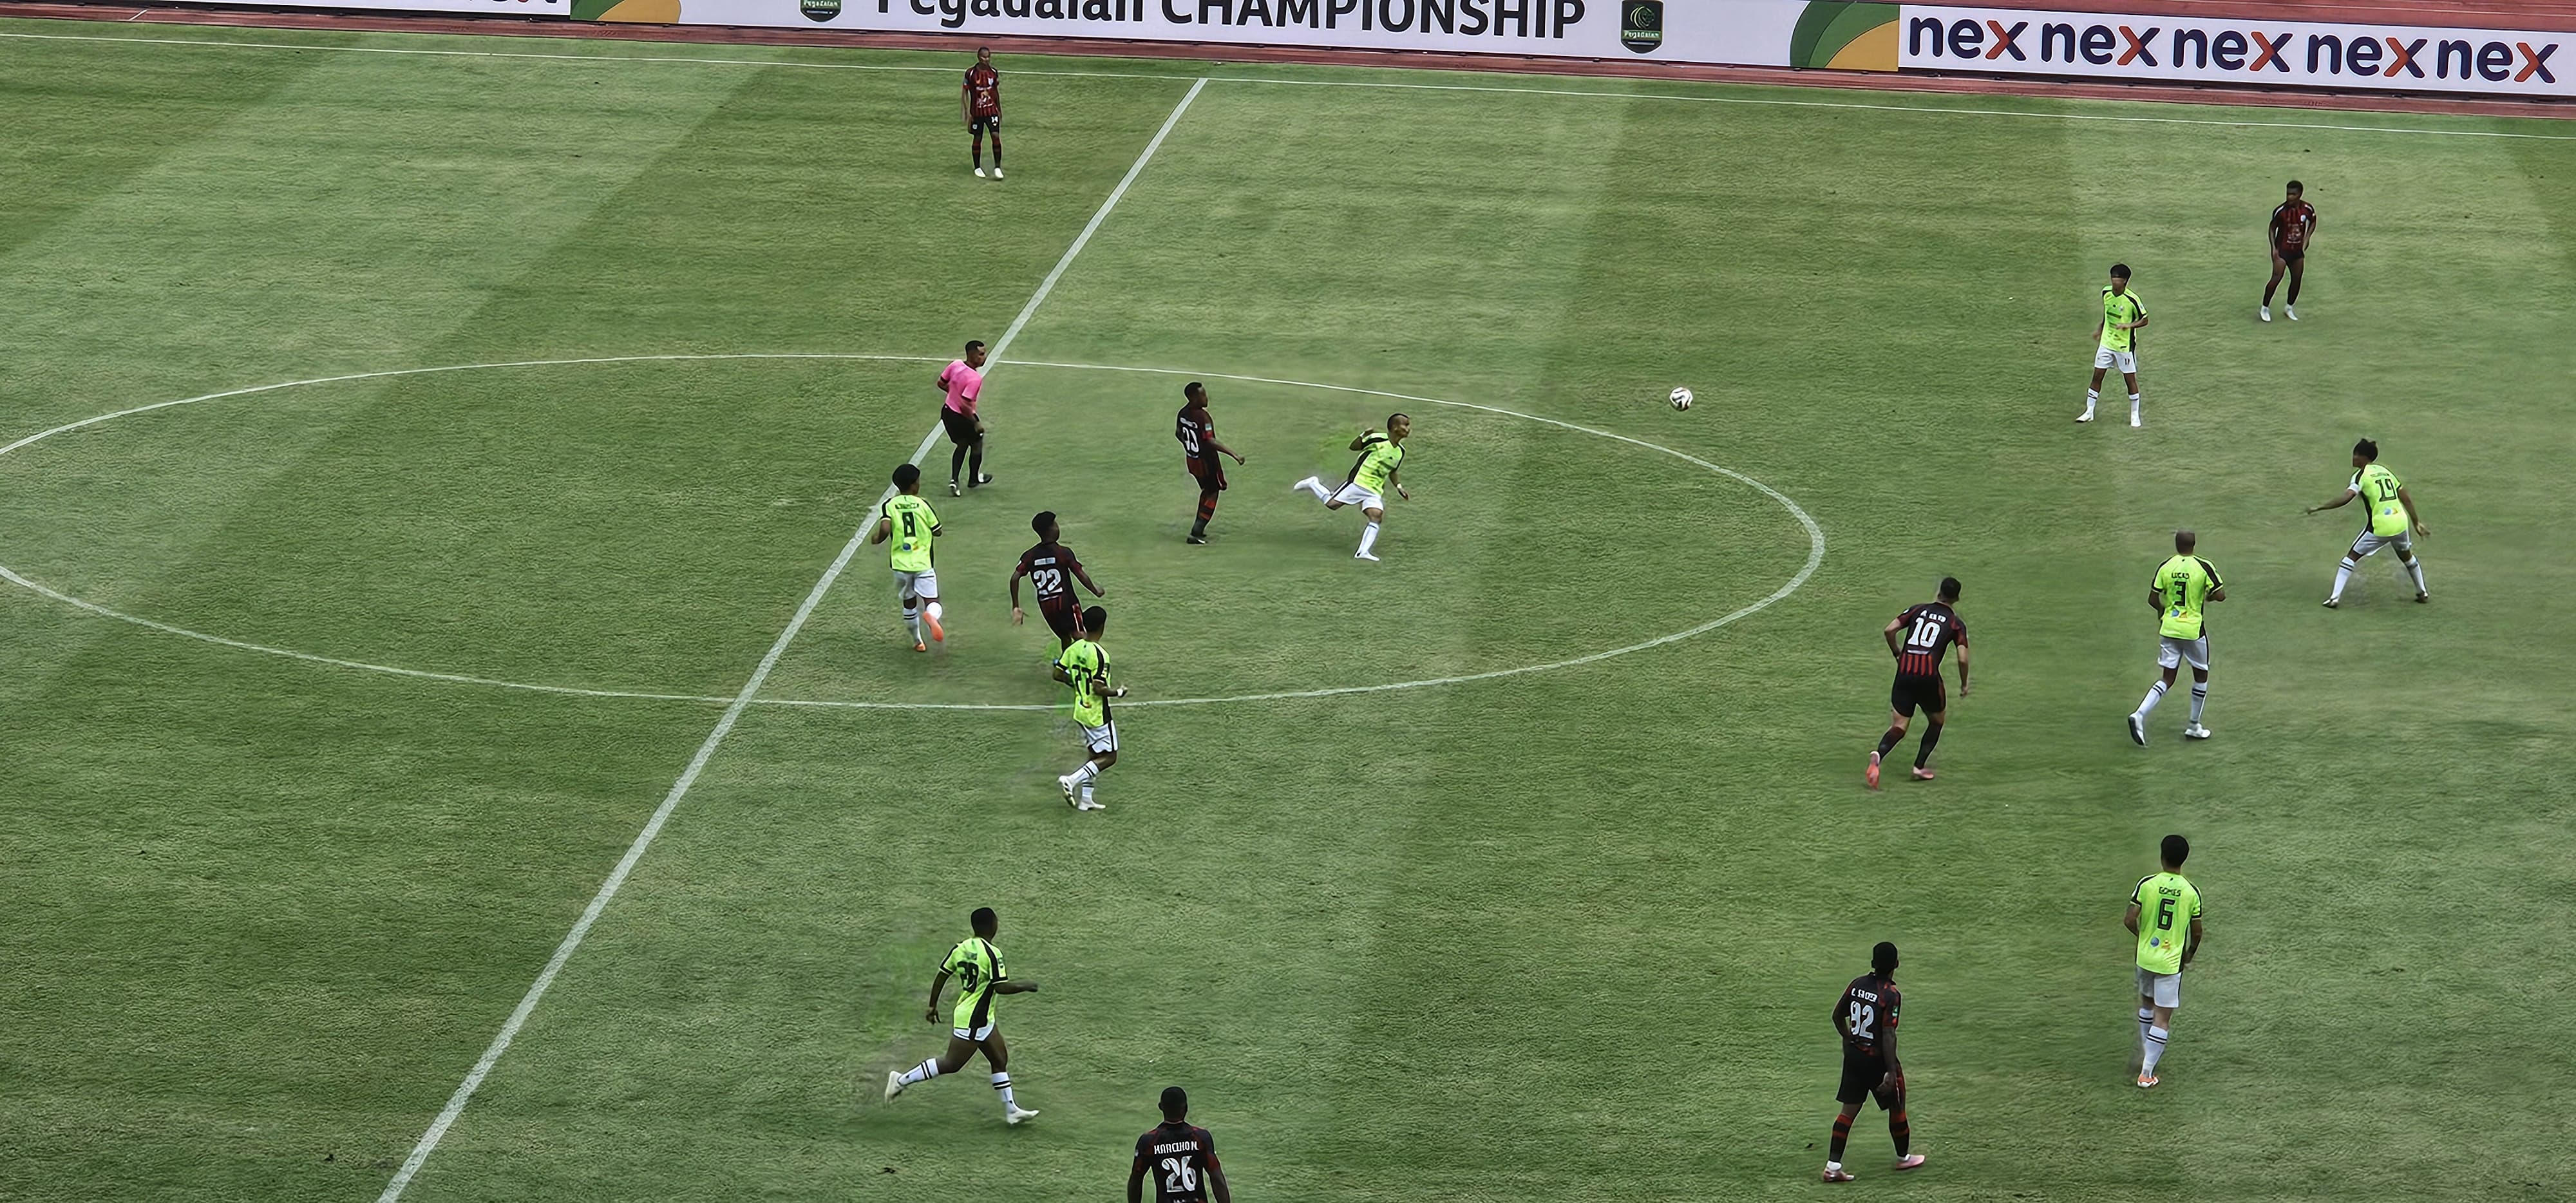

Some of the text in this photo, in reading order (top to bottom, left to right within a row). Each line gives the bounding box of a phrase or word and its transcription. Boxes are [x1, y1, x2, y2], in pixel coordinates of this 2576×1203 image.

[1162, 0, 1586, 39] CHAMPIONSHIP
[1909, 17, 2558, 83] nex nex nex nex nex
[2375, 478, 2397, 502] 19
[1034, 569, 1063, 595] 22
[2174, 581, 2186, 607] 3
[1908, 617, 1940, 648] 10
[2157, 898, 2175, 931] 6
[1850, 1001, 1874, 1039] 92
[1161, 1155, 1197, 1193] 26
